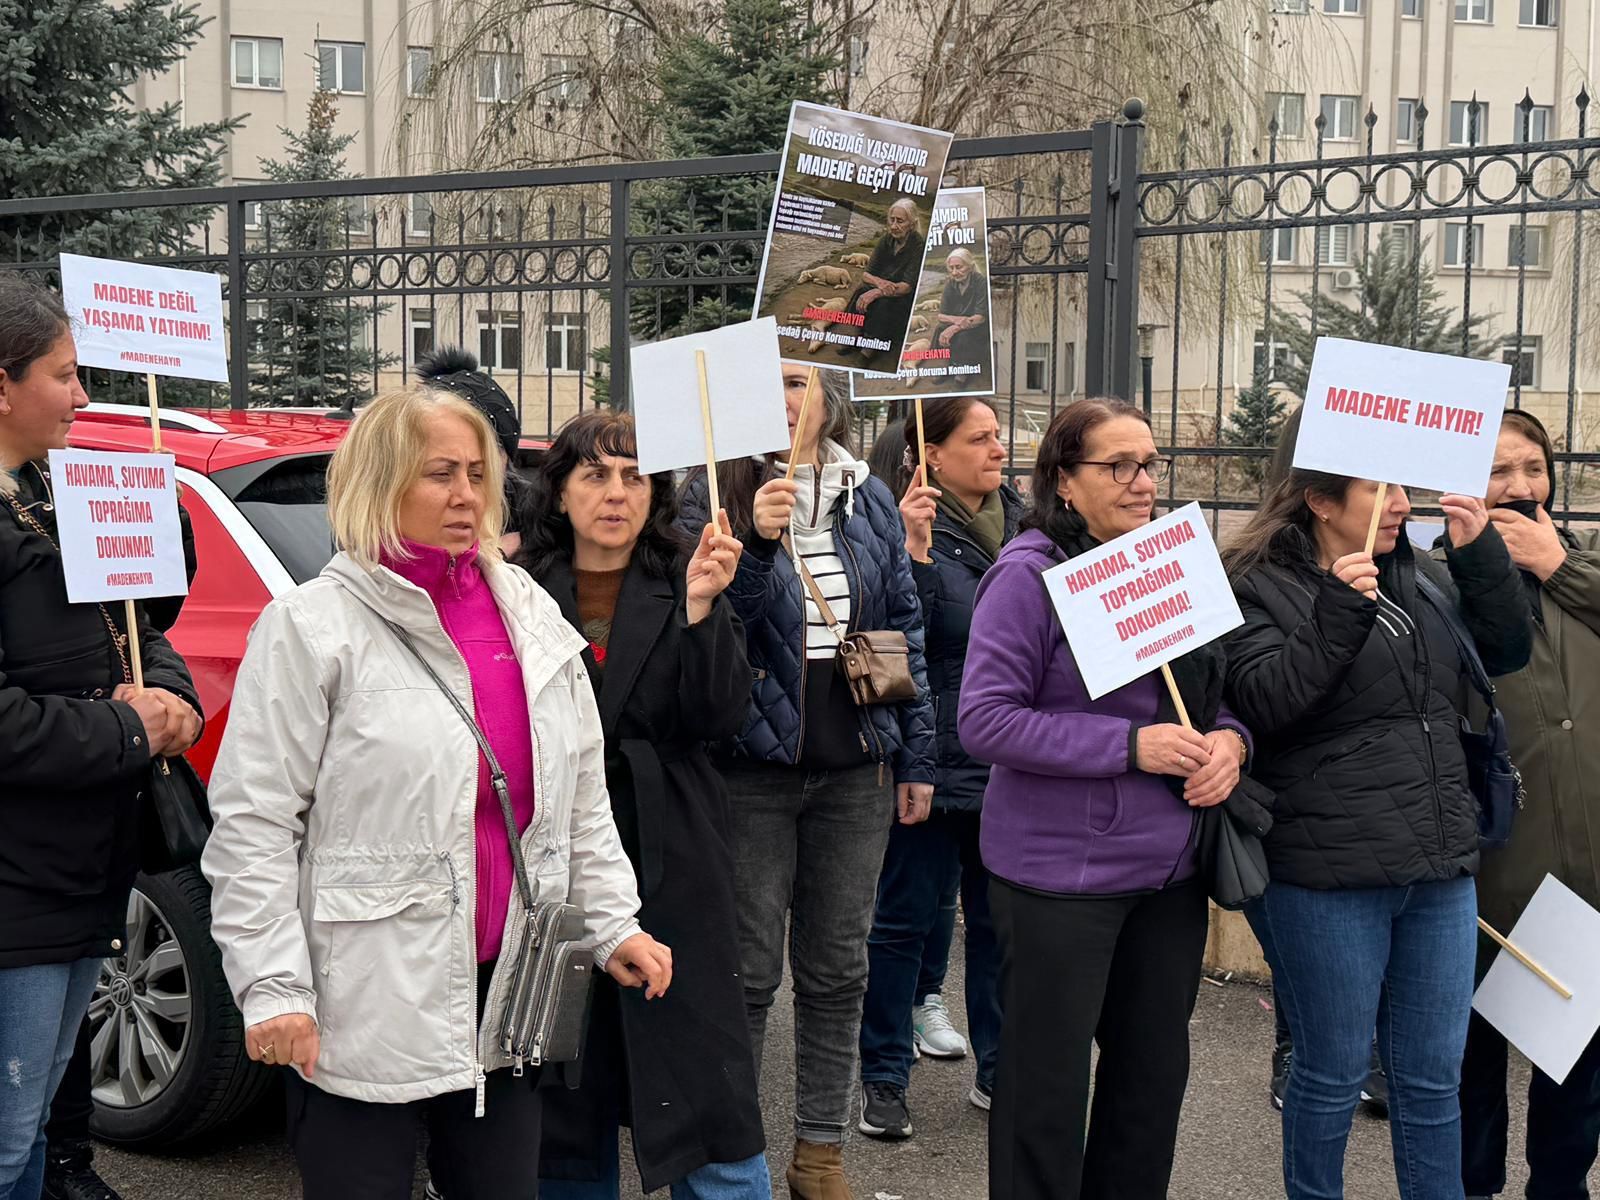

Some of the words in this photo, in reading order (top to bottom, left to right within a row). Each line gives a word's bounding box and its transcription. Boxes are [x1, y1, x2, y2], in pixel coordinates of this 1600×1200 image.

[808, 125, 864, 154] KÖSEDAĞ
[867, 139, 928, 167] YAŞAMDIR
[796, 153, 855, 183] MADENE
[856, 165, 895, 193] GEÇİT
[897, 172, 929, 196] YOK!
[932, 207, 968, 223] AMDIR
[946, 227, 975, 245] YOK!
[93, 283, 154, 308] MADENE
[158, 290, 198, 313] DEĞİL
[82, 308, 145, 333] YAŞAMA
[149, 317, 212, 341] YATIRIM!
[776, 325, 801, 339] sedağ
[801, 328, 824, 342] Çevre
[825, 331, 855, 346] Koruma
[856, 336, 891, 351] Komitesi
[120, 351, 181, 367] #MADENEHAYIR
[919, 367, 948, 377] Koruma
[948, 364, 981, 375] Komitesi
[1325, 386, 1411, 424] MADENE
[1415, 402, 1485, 436] HAYIR!
[65, 463, 119, 491] HAVAMA,
[121, 466, 166, 490] SUYUMA
[88, 496, 153, 523] TOPRAĞIMA
[96, 536, 155, 559] DOKUNMA!
[1065, 550, 1136, 595] HAVAMA,
[1134, 520, 1196, 563] SUYUMA
[107, 572, 153, 586] #MADENEHAYIR
[1100, 560, 1185, 613] TOPRAĞIMA
[1115, 590, 1193, 642] DOKUNMA!
[1135, 624, 1195, 662] #MADENEHAYIR
